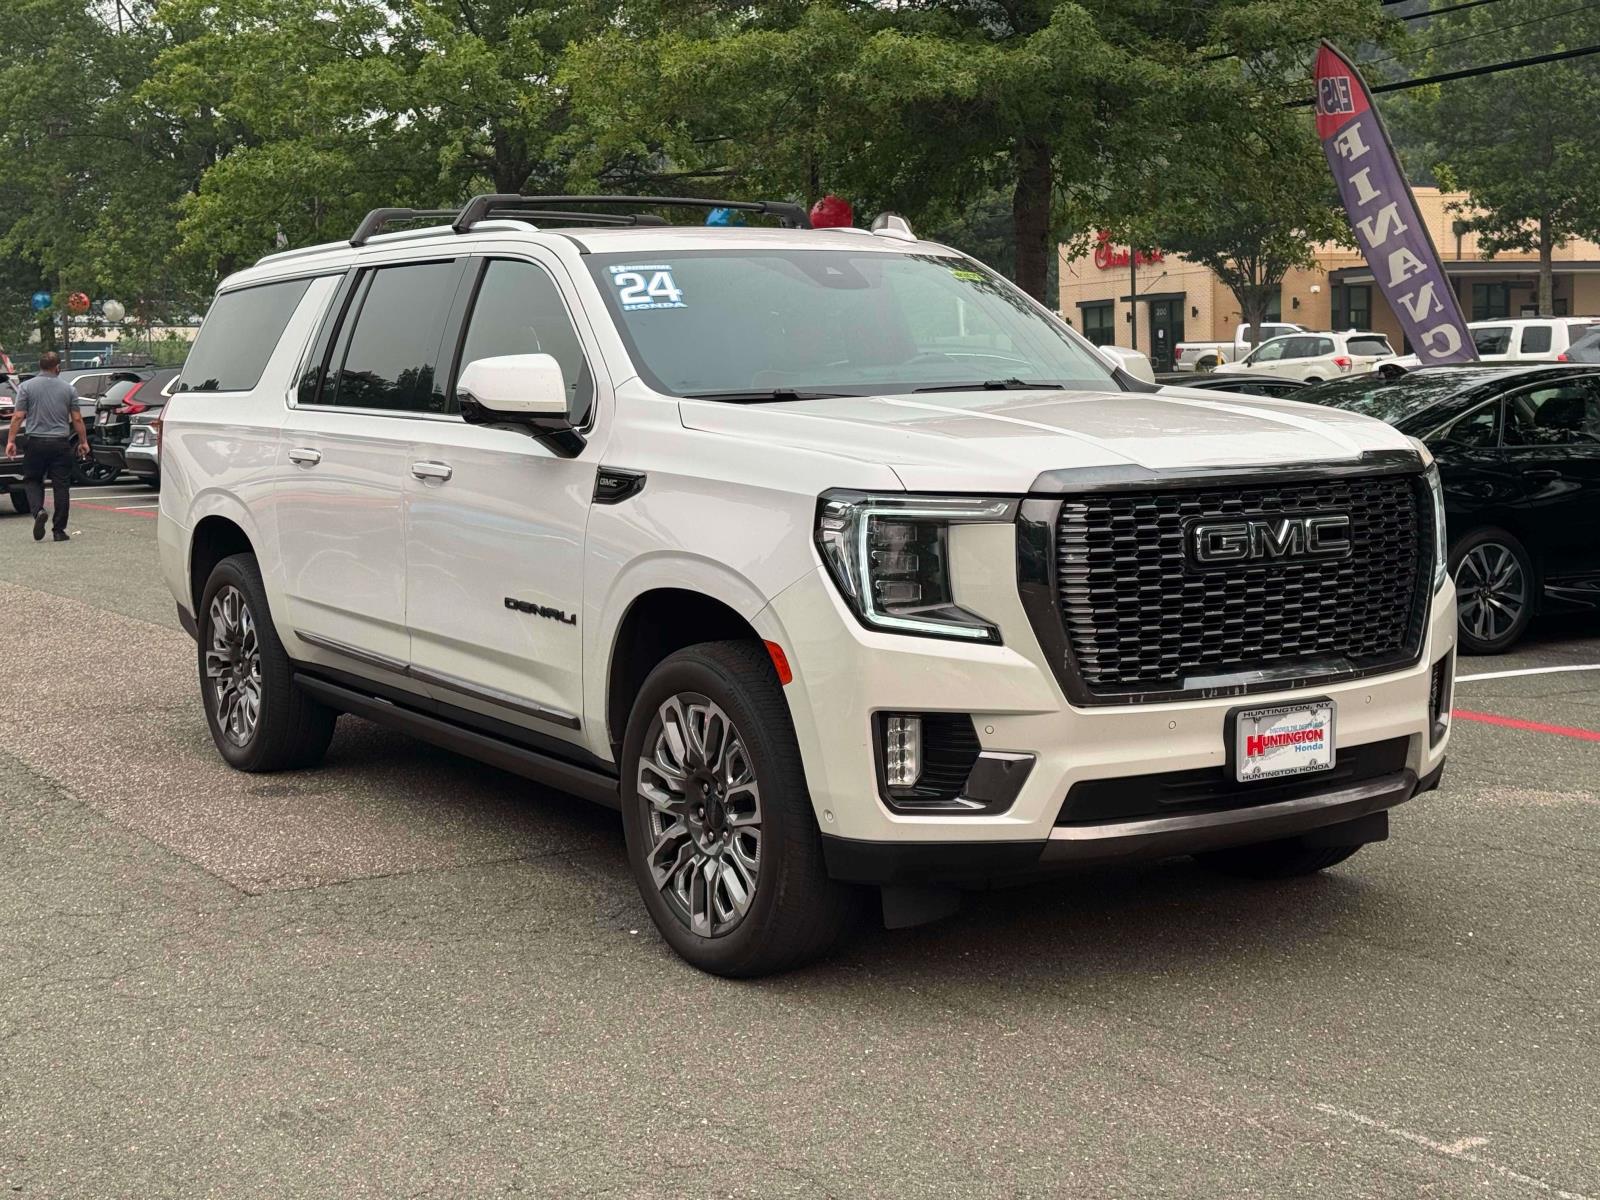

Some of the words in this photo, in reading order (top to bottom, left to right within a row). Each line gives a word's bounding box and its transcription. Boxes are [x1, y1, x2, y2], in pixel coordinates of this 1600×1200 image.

[614, 271, 683, 305] 24
[623, 302, 689, 311] HONDA
[600, 478, 618, 487] GMC
[1196, 515, 1350, 562] GMC
[504, 597, 577, 626] DENALI
[1243, 704, 1313, 718] HUNTINGTON,
[1246, 729, 1324, 758] HUNTINGTON
[1295, 743, 1323, 753] Honda
[1242, 768, 1298, 781] HUNTINGTON
[1299, 763, 1331, 773] HONDA
